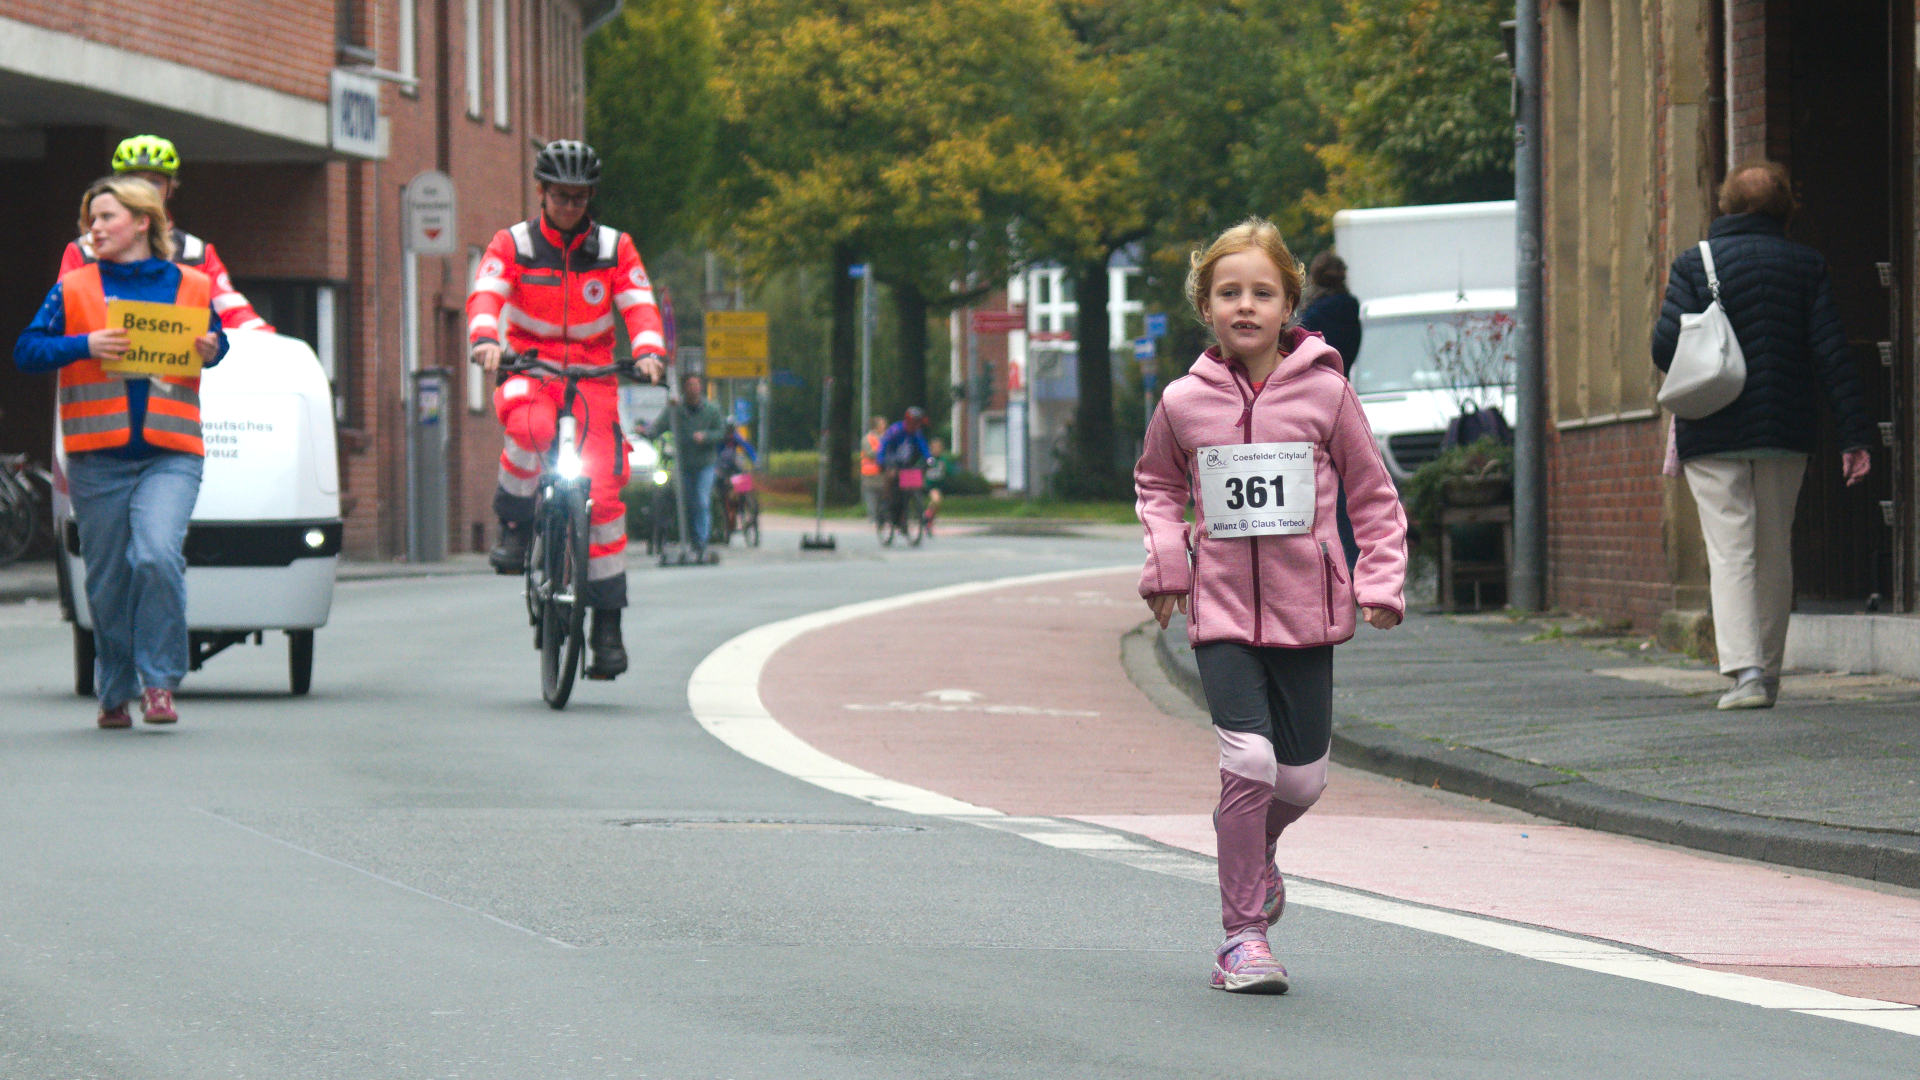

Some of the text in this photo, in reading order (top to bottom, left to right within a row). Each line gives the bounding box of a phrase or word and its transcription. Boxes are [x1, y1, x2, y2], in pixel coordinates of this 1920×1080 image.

[123, 312, 191, 334] Besen-
[117, 345, 191, 366] ahrrad
[205, 435, 238, 444] otes
[206, 448, 239, 458] reuz
[1232, 451, 1307, 462] Coesfelder Citylauf
[1225, 475, 1284, 510] 361
[1213, 518, 1306, 531] Allianz Claus Terbeck
